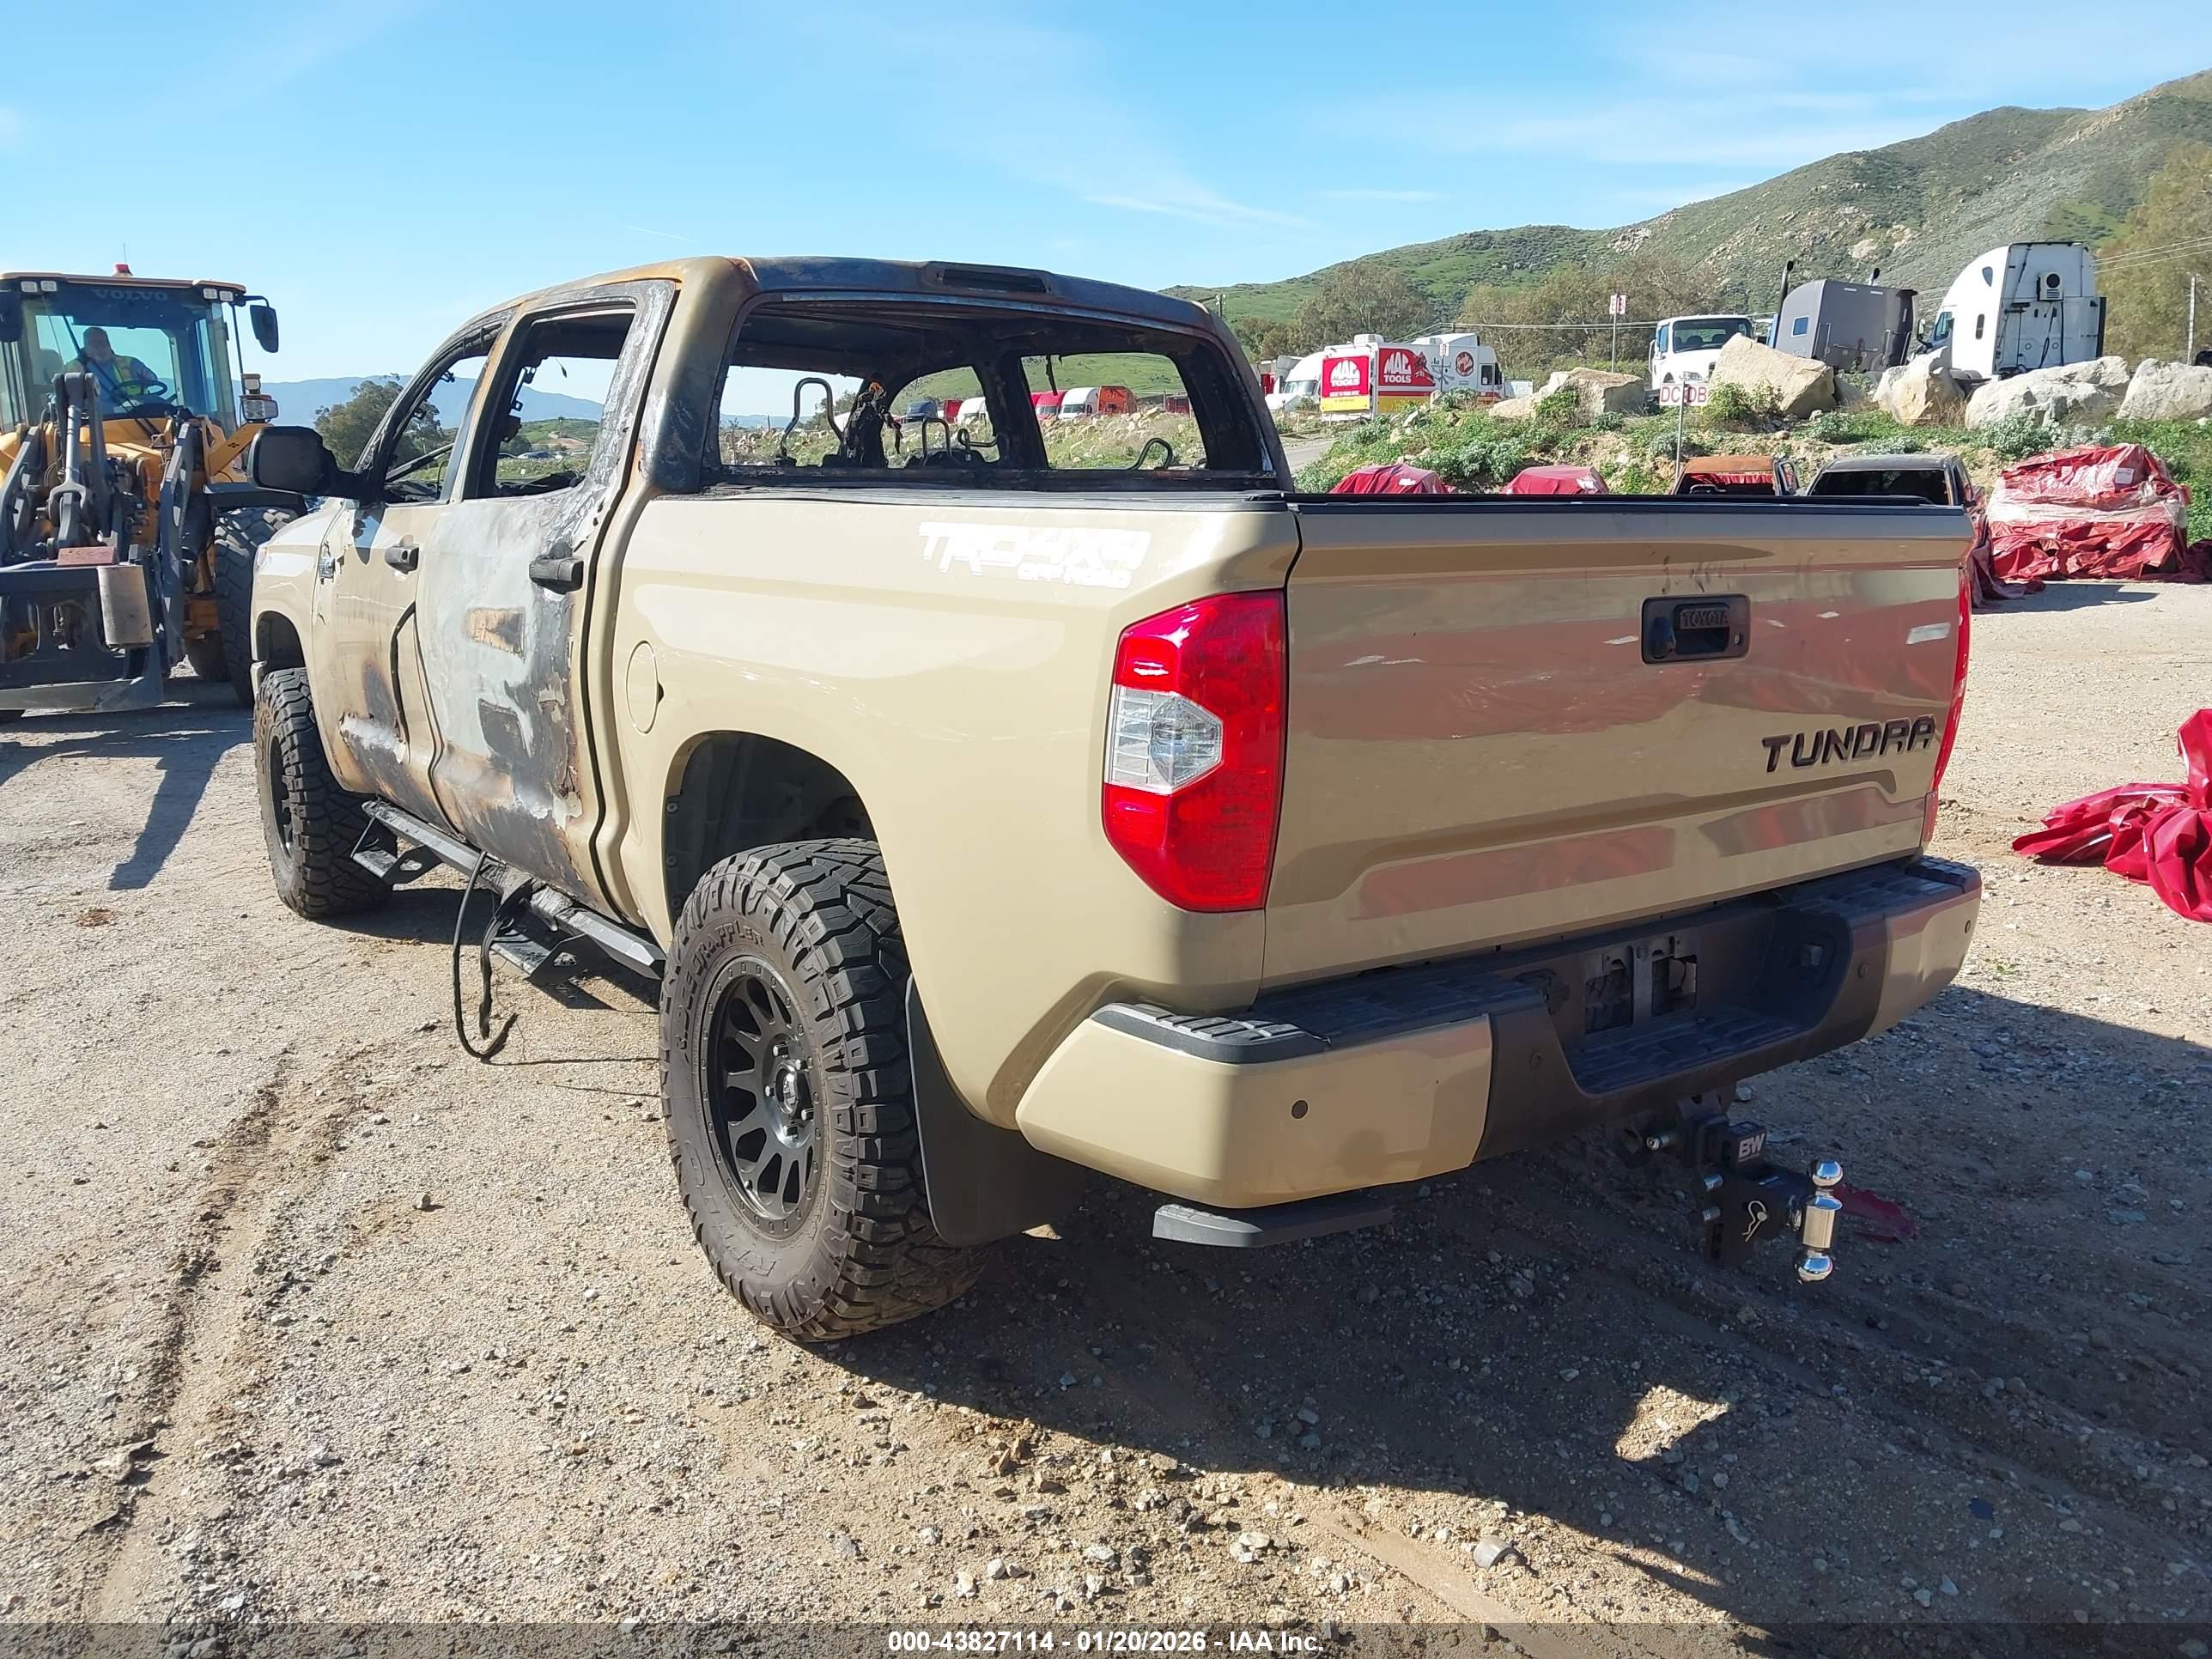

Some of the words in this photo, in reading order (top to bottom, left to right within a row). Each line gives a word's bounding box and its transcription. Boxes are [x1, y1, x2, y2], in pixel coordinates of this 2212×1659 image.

[91, 289, 169, 301] VOLVO
[1330, 360, 1361, 380] MAC
[1384, 351, 1412, 374] MAC
[1330, 379, 1361, 387] TOOLS
[1383, 374, 1412, 383] TOOLS
[1661, 386, 1681, 403] DC
[1686, 386, 1707, 403] DB
[1683, 609, 1729, 629] TOYOTA
[1761, 713, 1936, 774] TUNDRA
